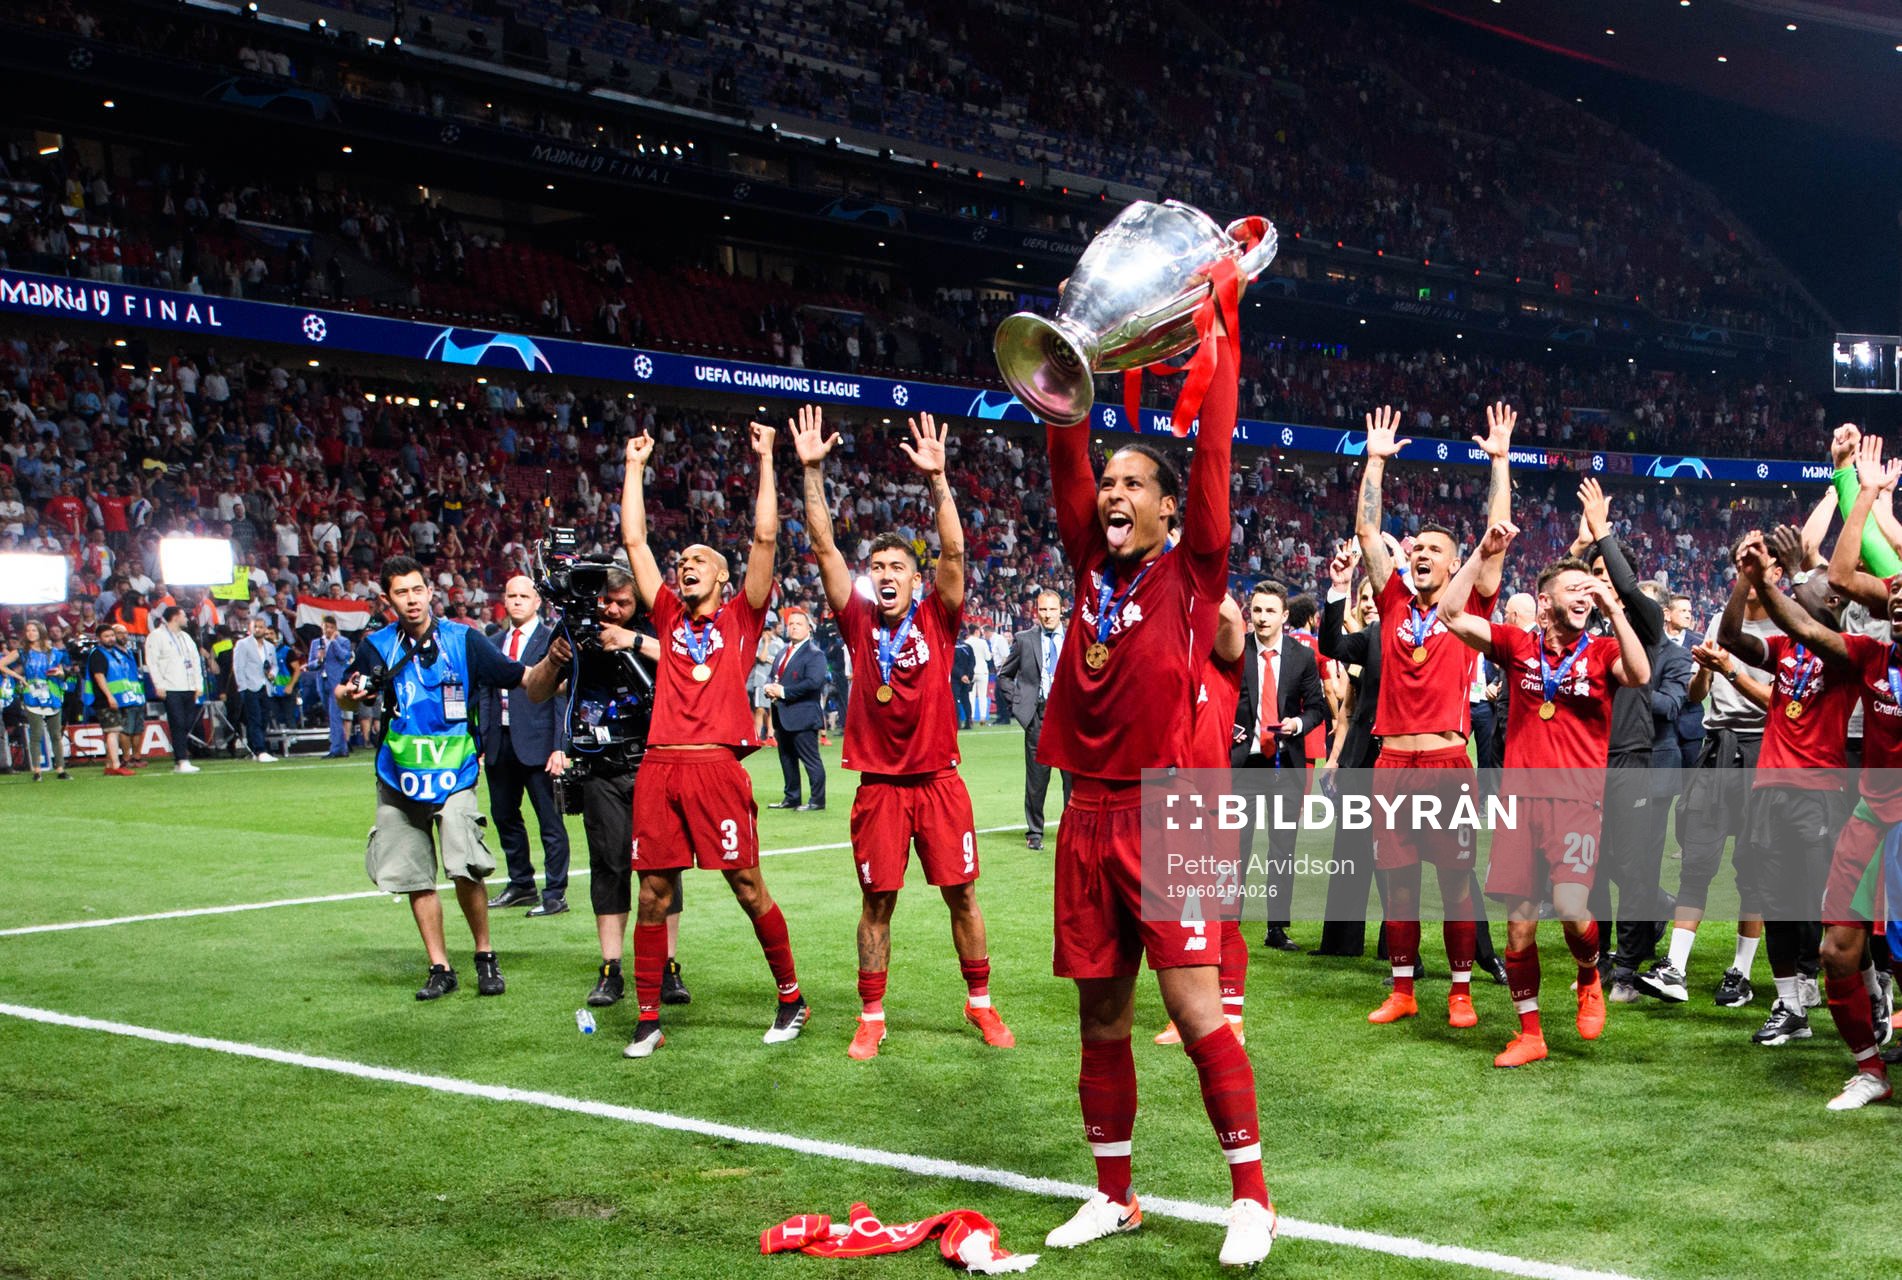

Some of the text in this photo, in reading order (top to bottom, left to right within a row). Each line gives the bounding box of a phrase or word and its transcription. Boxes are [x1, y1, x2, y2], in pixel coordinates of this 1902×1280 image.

[609, 160, 670, 184] FINAL
[1049, 242, 1085, 256] CHAMP
[93, 290, 110, 316] 19
[124, 295, 222, 326] FINAL
[694, 366, 861, 398] UEFA CHAMPIONS LEAGUE
[1507, 452, 1538, 465] MPIONS
[412, 738, 449, 766] TV
[400, 771, 457, 799] 010
[721, 819, 738, 851] 3
[962, 831, 973, 863] 9
[1562, 831, 1595, 868] 20
[1180, 886, 1206, 935] 4
